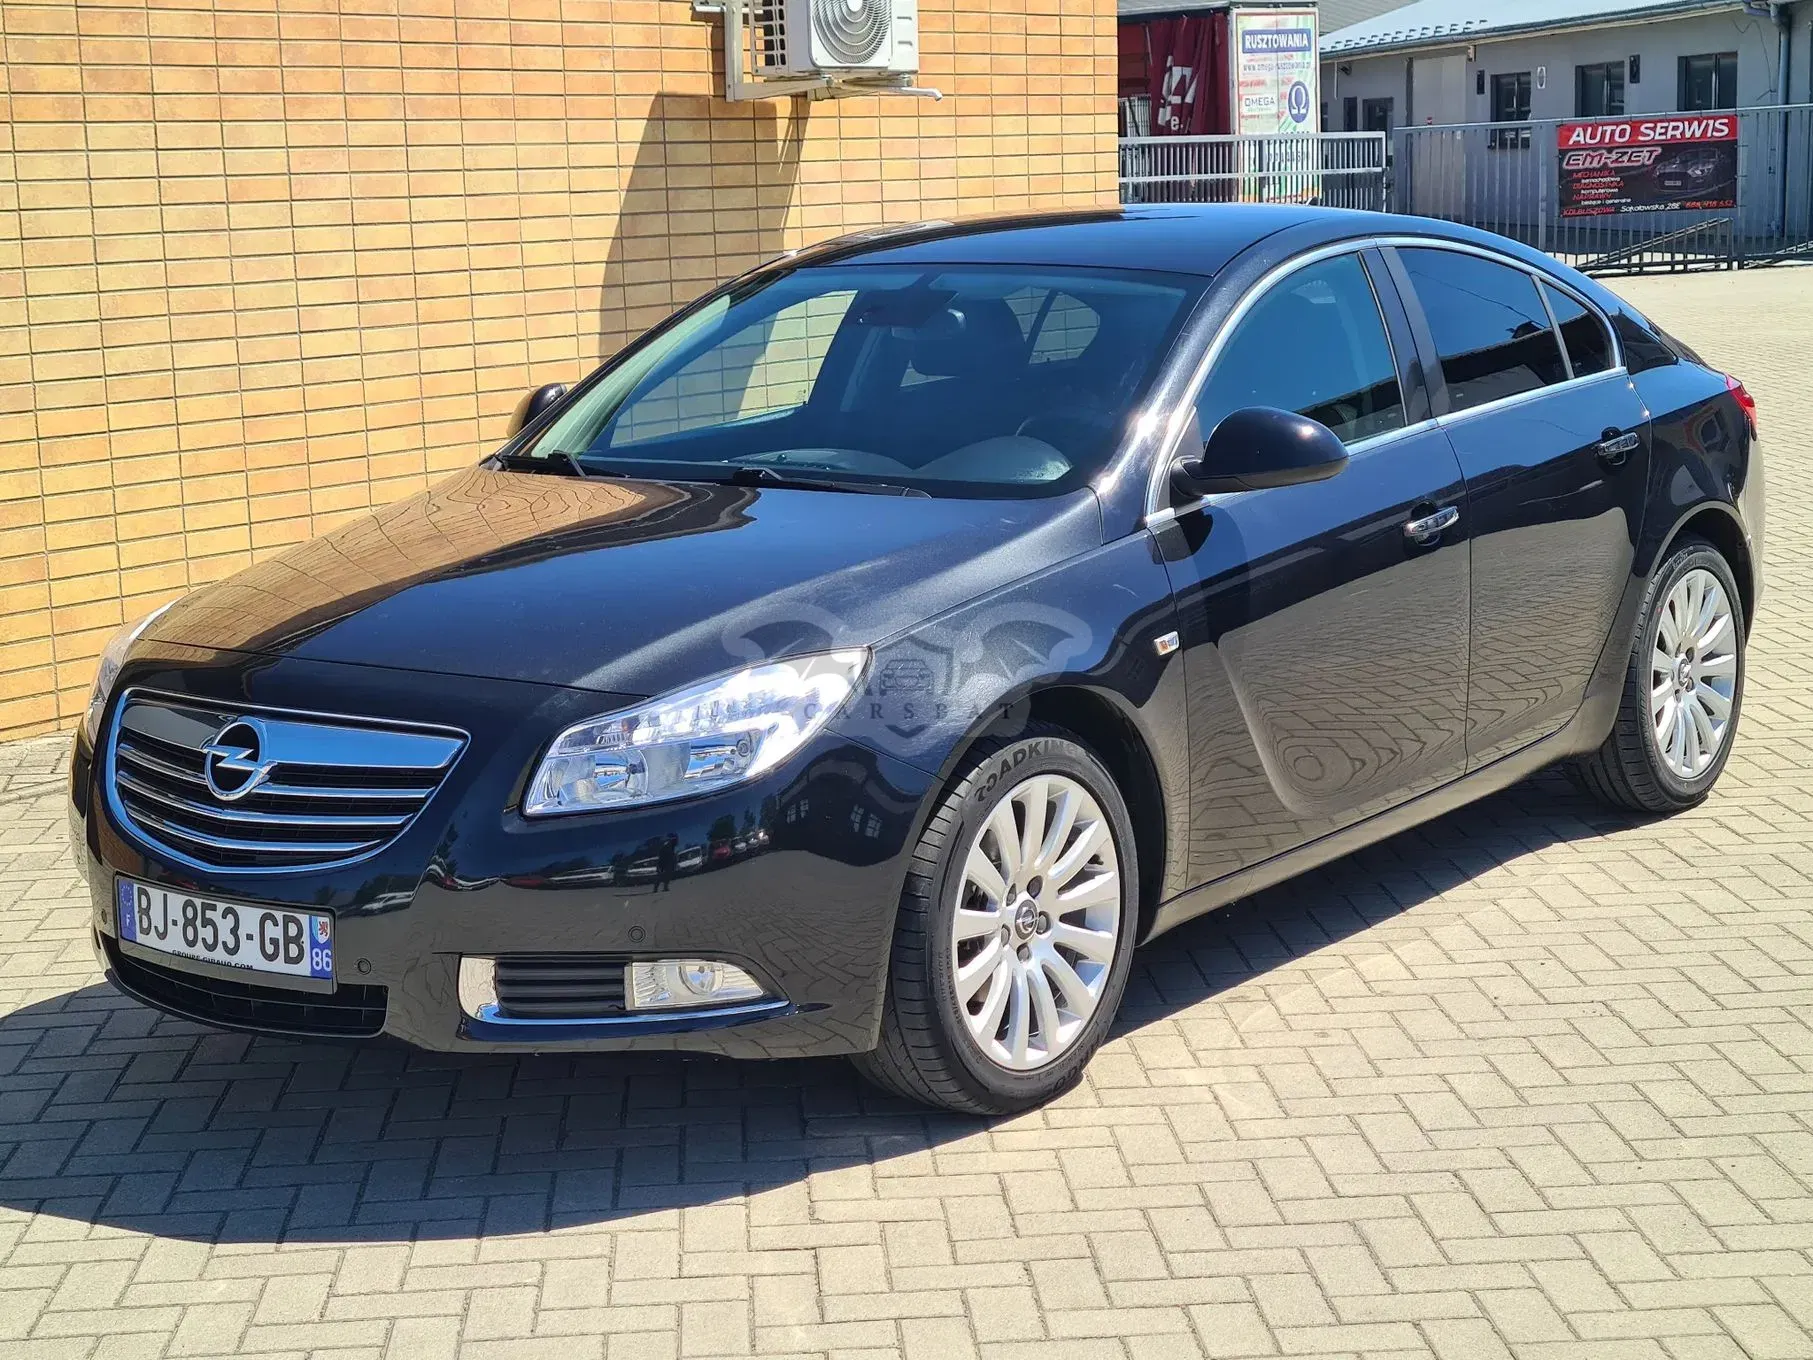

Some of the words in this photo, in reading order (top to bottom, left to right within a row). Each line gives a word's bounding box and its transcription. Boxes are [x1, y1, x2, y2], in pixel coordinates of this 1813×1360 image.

[1245, 33, 1309, 49] RUSZTOWANIA
[1244, 97, 1275, 107] OMEGA
[1568, 124, 1631, 145] AUTO
[1637, 118, 1729, 141] SERWIS
[1562, 147, 1662, 170] EM-ZET
[1573, 170, 1616, 178] MECHANIKA
[1573, 181, 1624, 189] DIAGNOSTYKA
[125, 914, 131, 926] F
[137, 886, 305, 965] BJ-853-GB
[311, 947, 332, 971] 86
